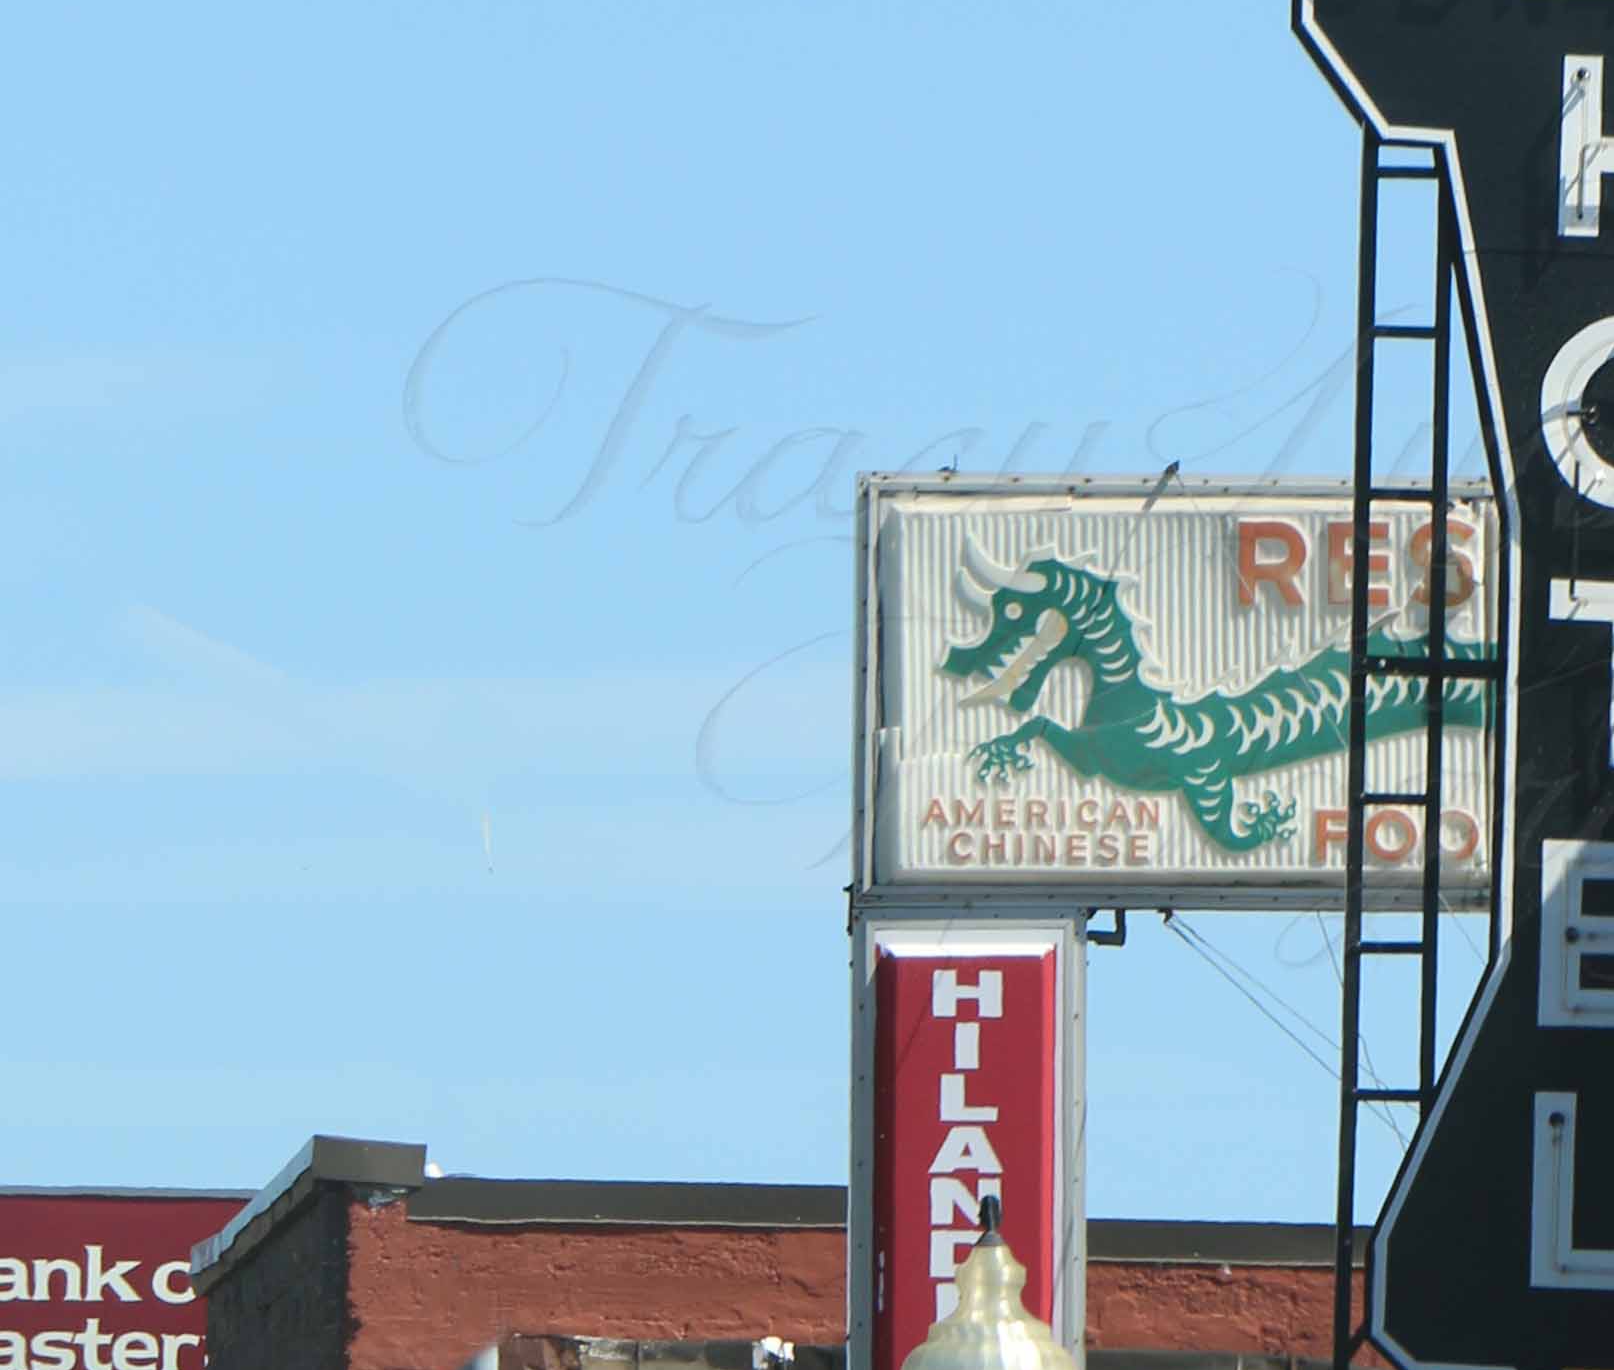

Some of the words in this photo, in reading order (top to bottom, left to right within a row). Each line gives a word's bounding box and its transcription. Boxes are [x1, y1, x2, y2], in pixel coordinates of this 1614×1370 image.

[921, 798, 1161, 829] AMERICAN
[1315, 808, 1479, 862] FOO
[948, 832, 1151, 866] CHINESE
[0, 1244, 143, 1303] ank
